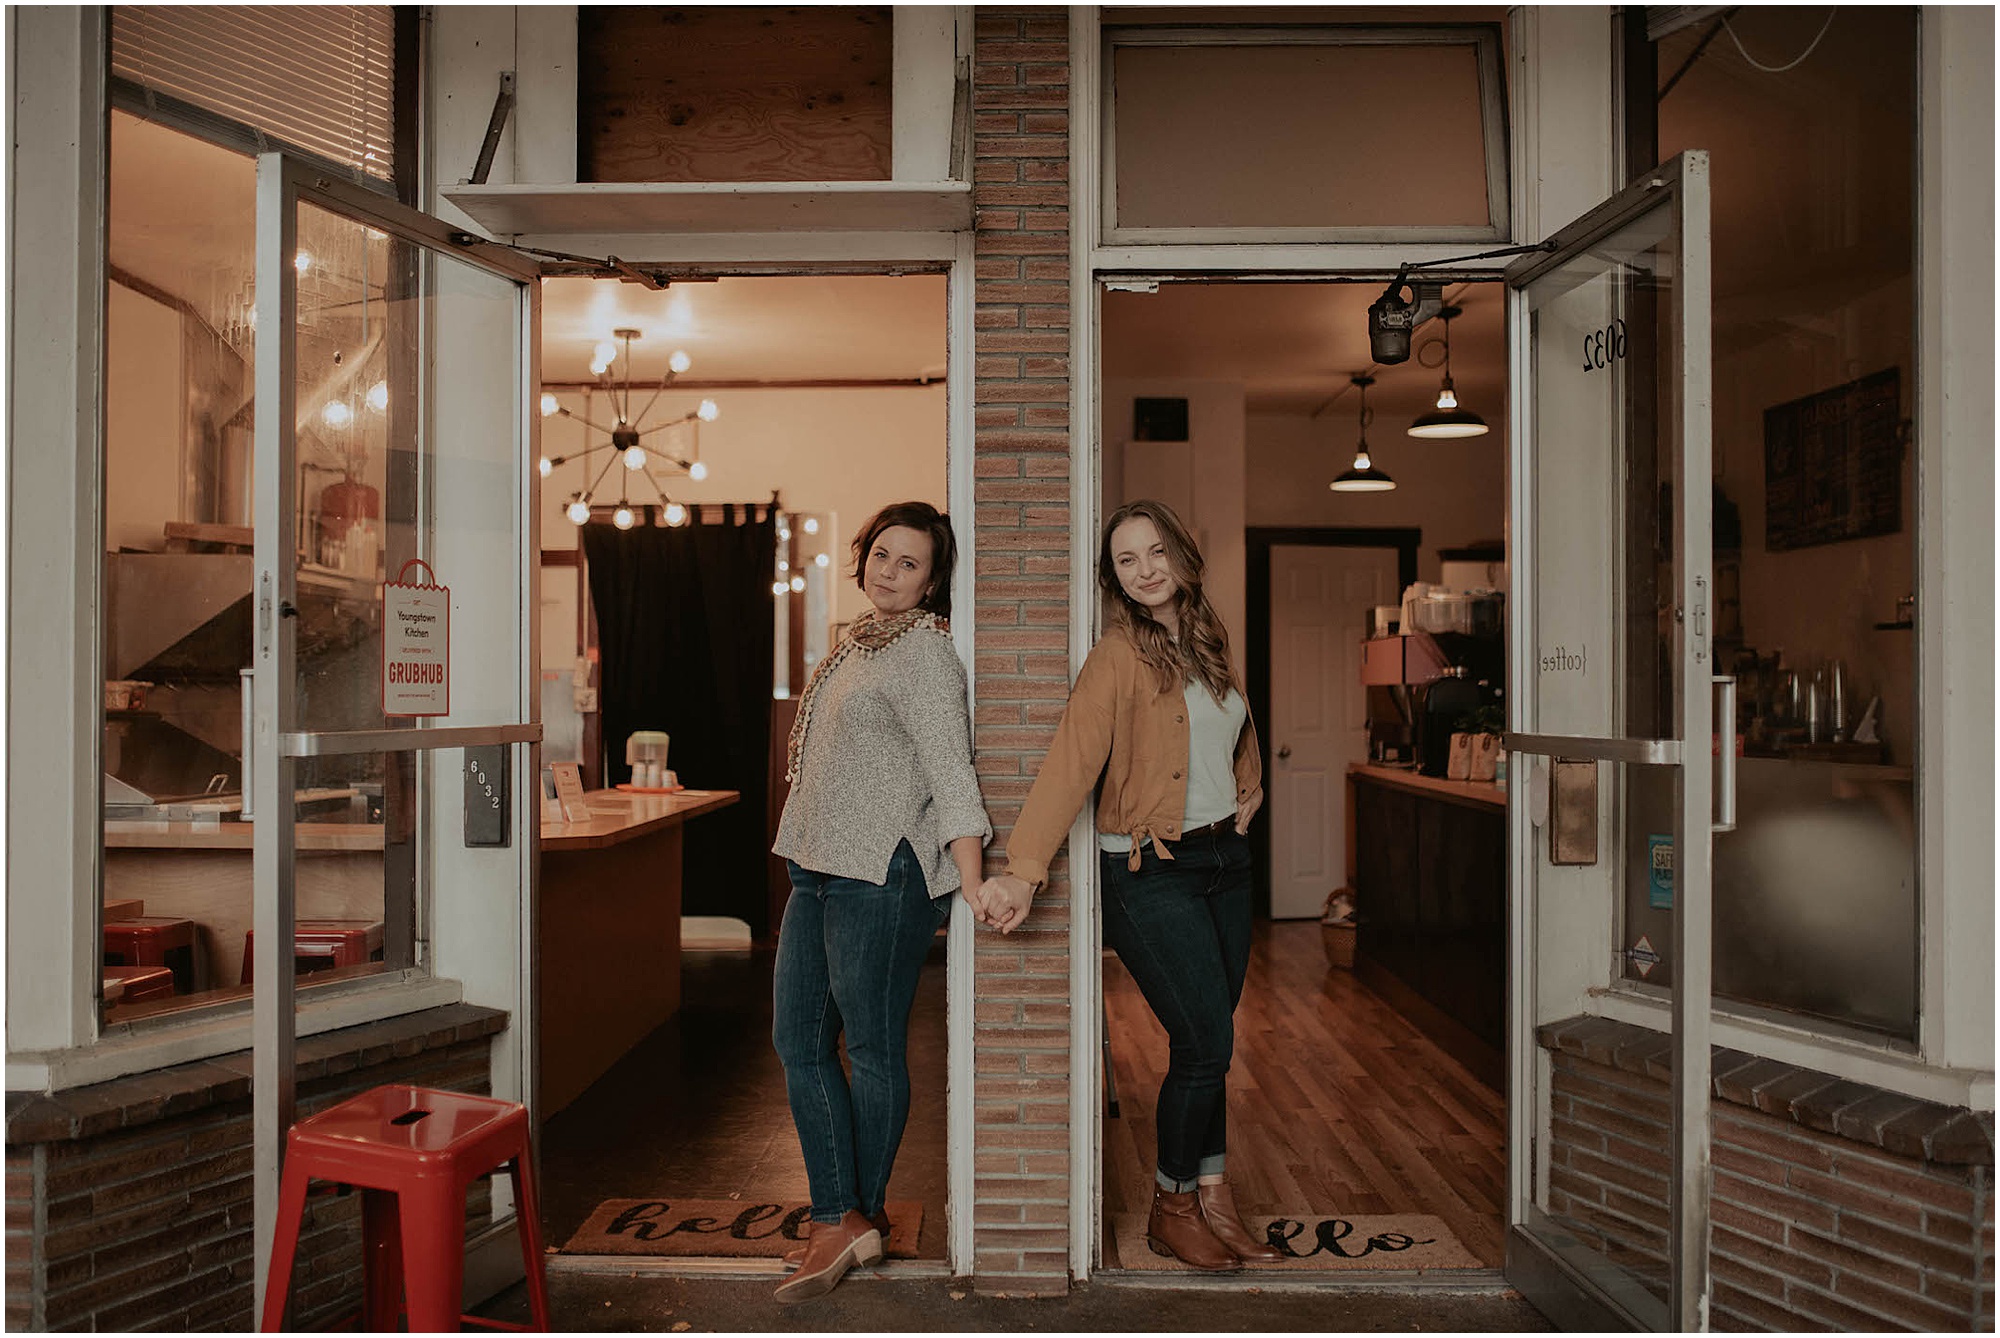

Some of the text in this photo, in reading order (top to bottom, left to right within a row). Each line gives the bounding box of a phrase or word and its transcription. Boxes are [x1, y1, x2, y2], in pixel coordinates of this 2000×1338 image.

[397, 610, 436, 624] Youngstown
[404, 627, 429, 638] Kitchen
[389, 661, 443, 684] GRUBHUB
[605, 1201, 811, 1241] hell
[1265, 1218, 1437, 1258] llo
